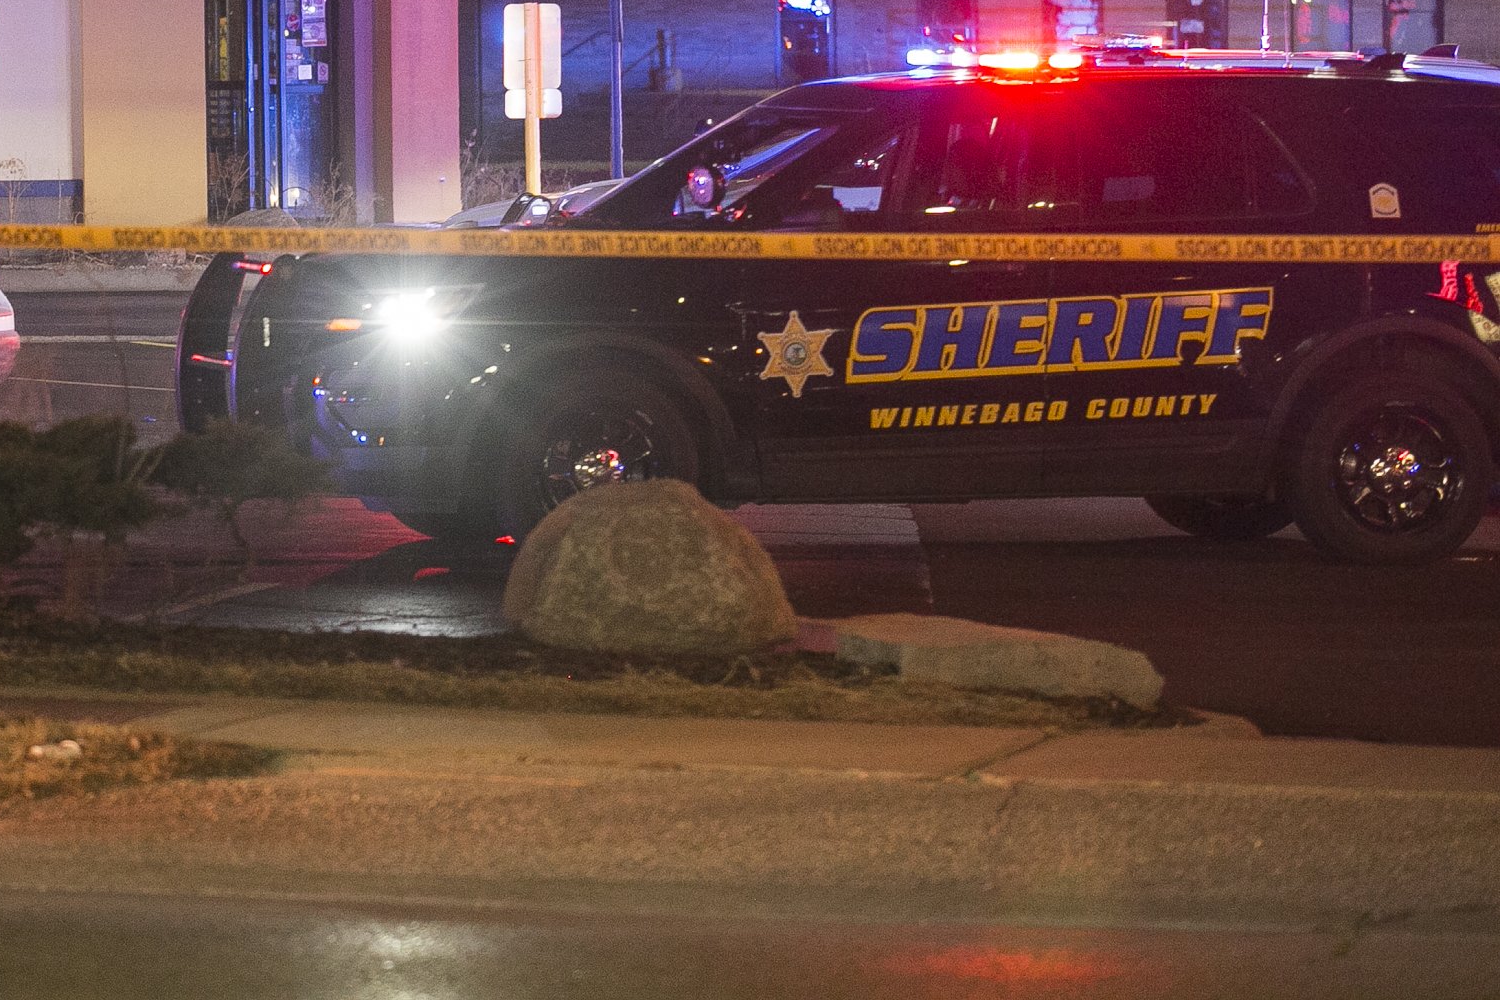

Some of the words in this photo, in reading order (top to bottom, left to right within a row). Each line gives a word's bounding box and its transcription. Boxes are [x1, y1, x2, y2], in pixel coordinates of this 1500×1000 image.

[846, 286, 1275, 384] SHERIFF
[869, 400, 1068, 430] WINNEBAGO
[1086, 393, 1218, 420] COUNTY
